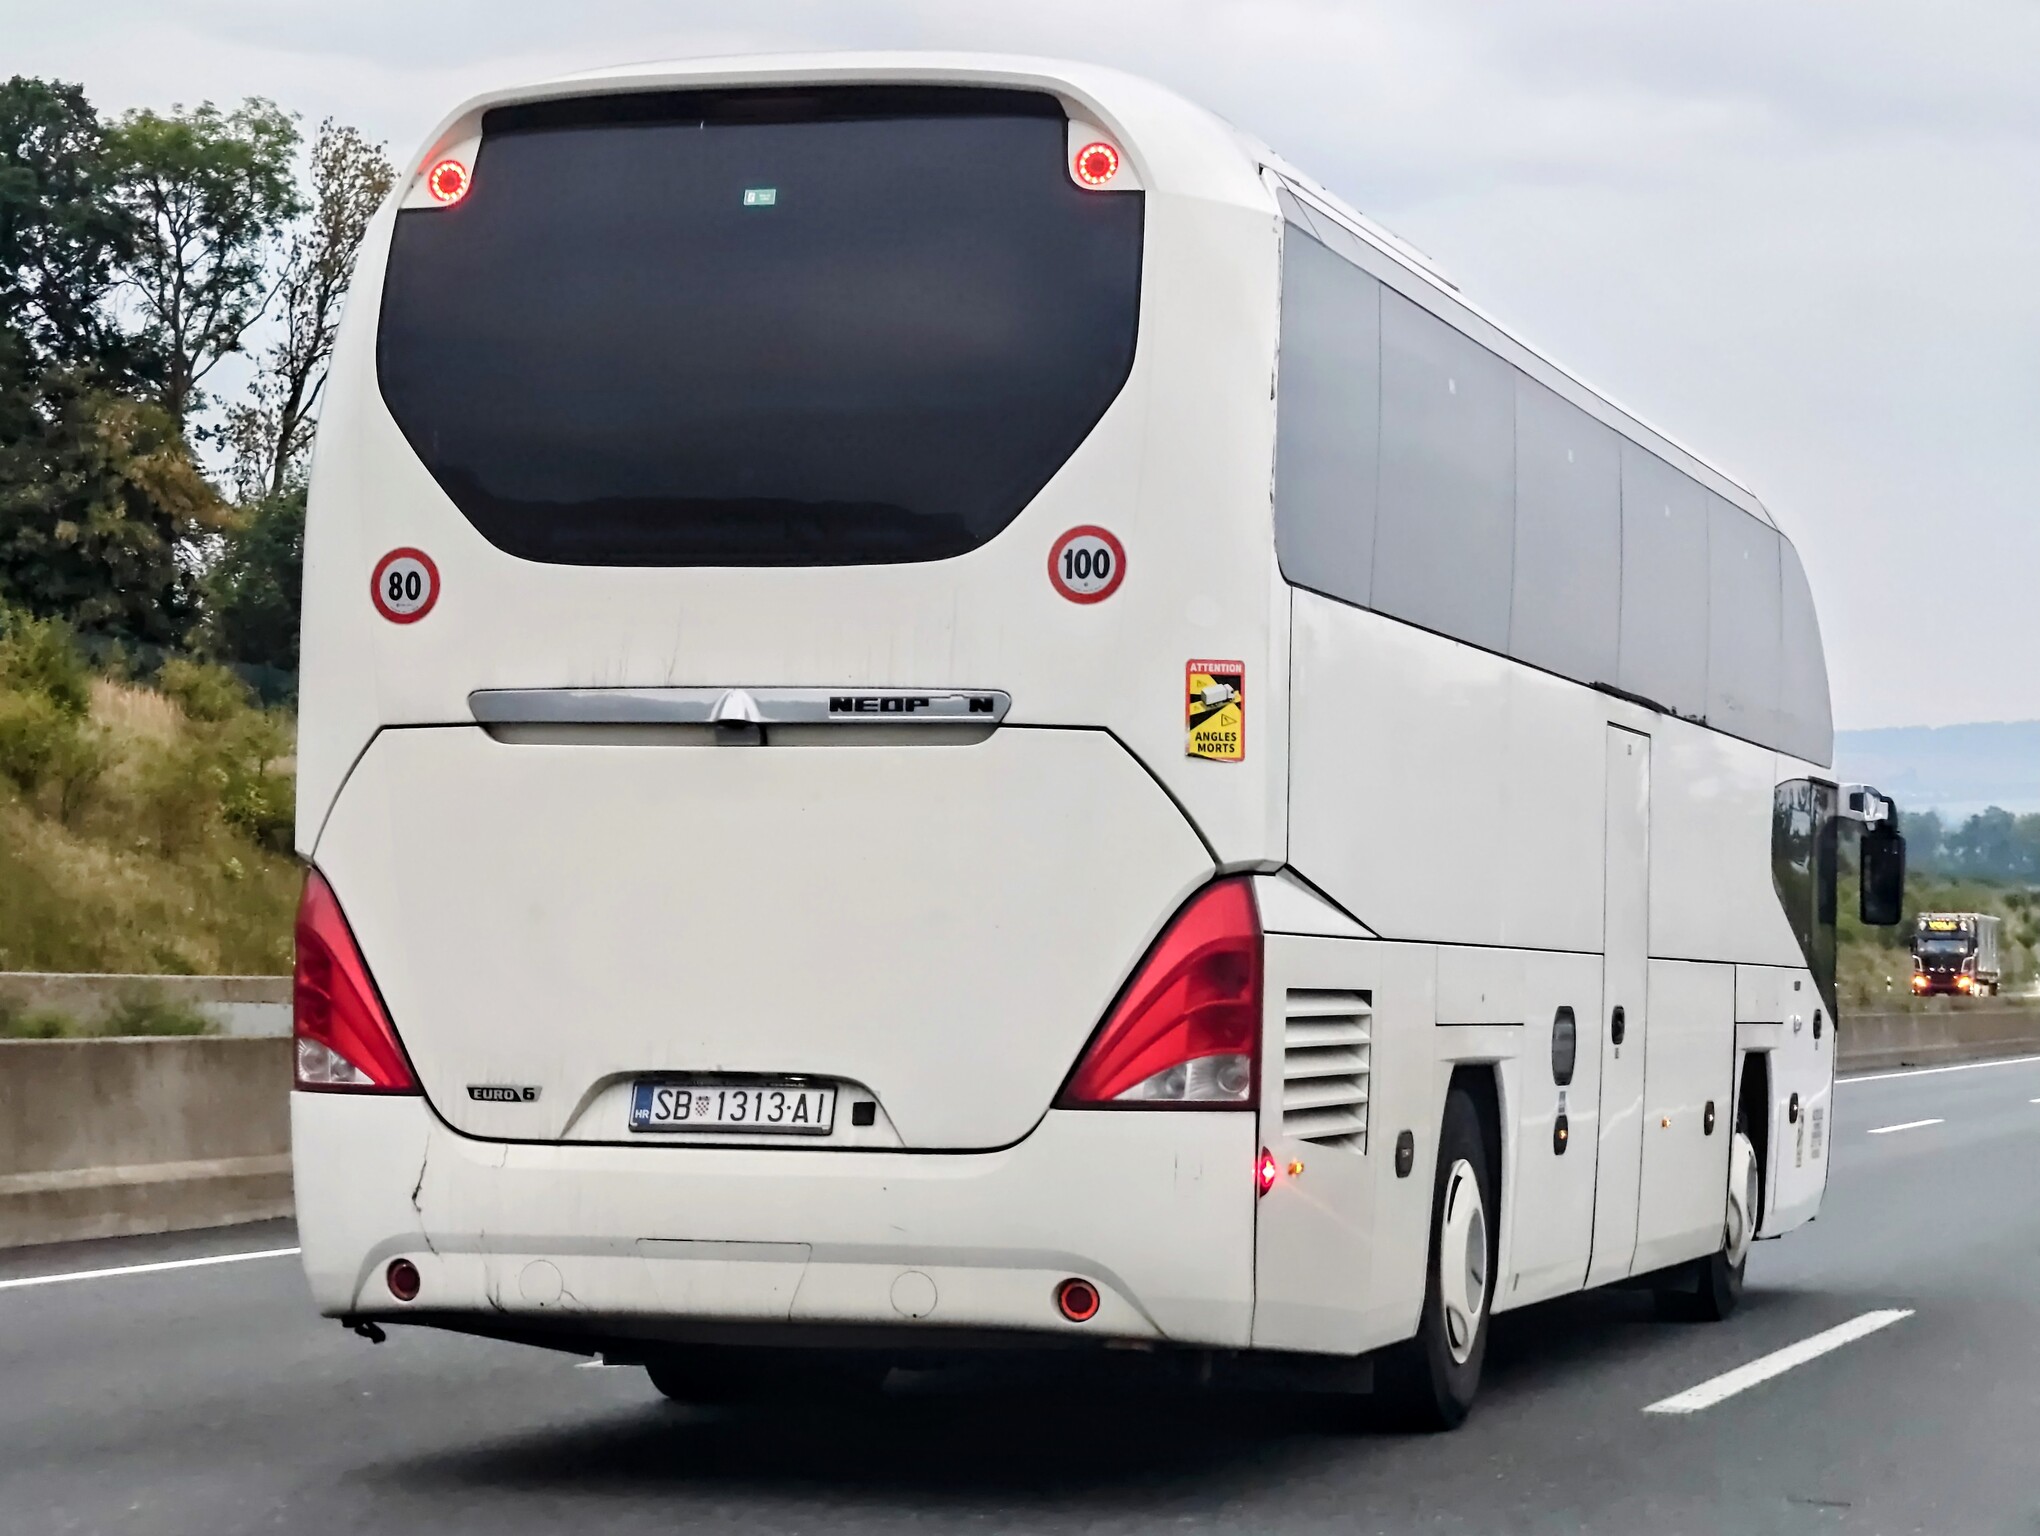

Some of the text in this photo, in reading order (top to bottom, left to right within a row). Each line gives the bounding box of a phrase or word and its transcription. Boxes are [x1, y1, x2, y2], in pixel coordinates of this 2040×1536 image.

[1064, 548, 1110, 579] 100
[388, 571, 421, 601] 80
[1190, 663, 1242, 673] ATTENTION
[829, 696, 994, 712] NEOPN
[1195, 731, 1237, 742] ANGLES
[1197, 743, 1235, 753] MORTS
[473, 1087, 535, 1101] EURO 6
[655, 1089, 692, 1121] SB
[634, 1108, 650, 1120] HR
